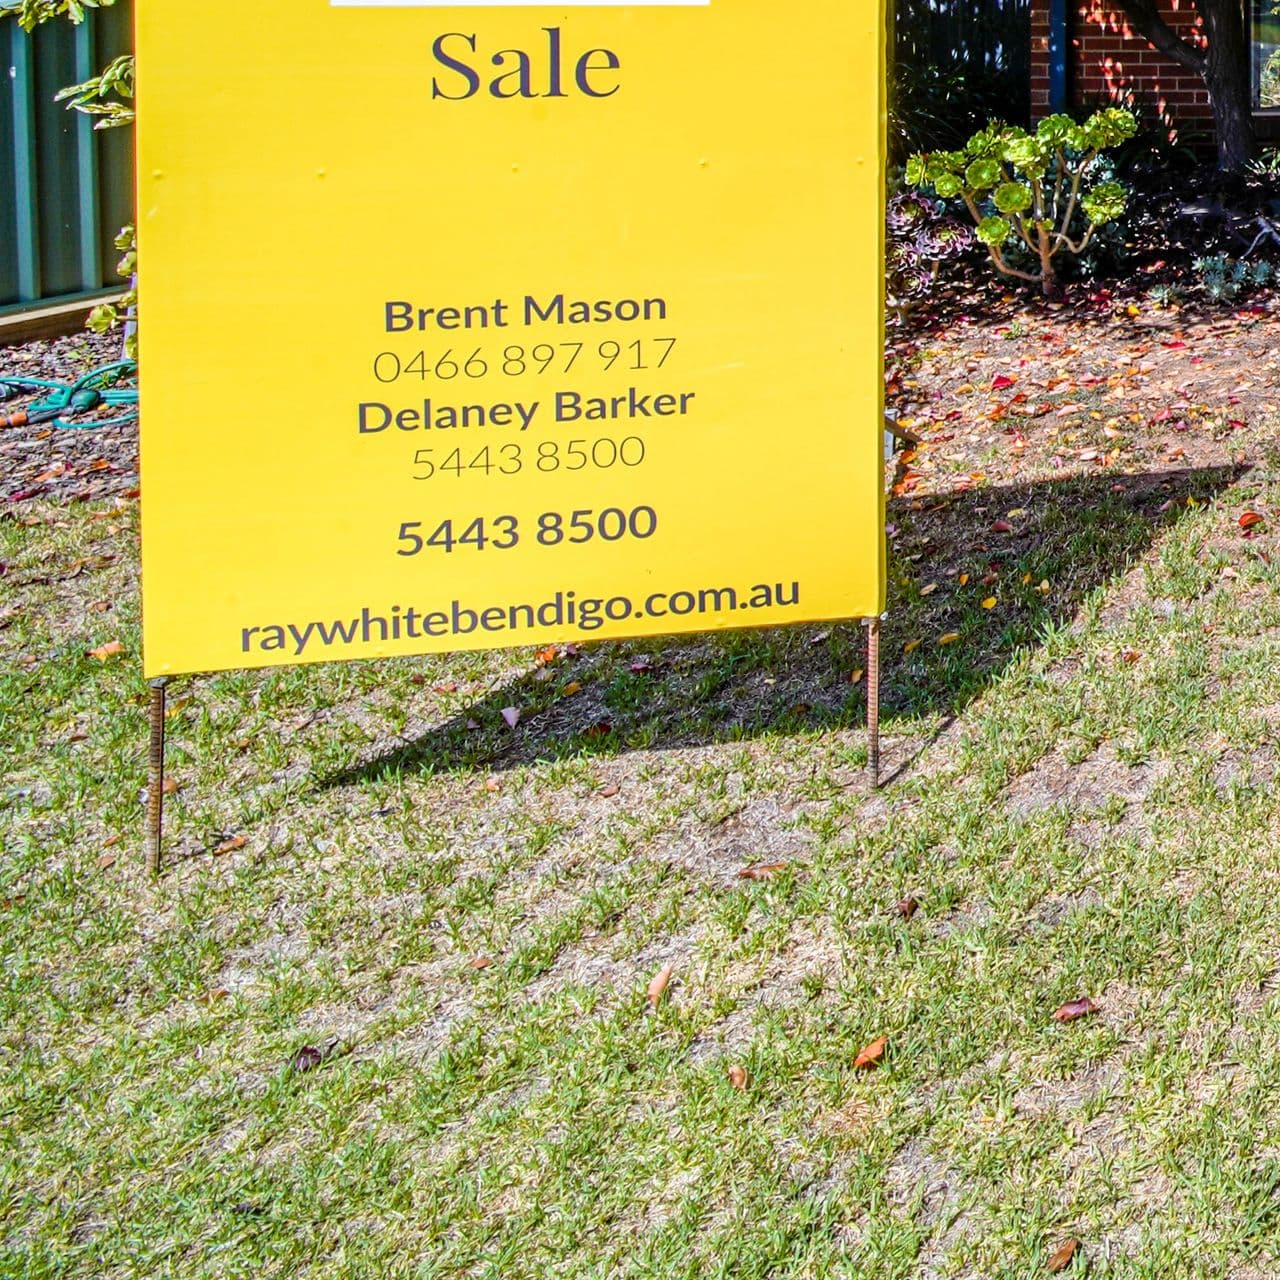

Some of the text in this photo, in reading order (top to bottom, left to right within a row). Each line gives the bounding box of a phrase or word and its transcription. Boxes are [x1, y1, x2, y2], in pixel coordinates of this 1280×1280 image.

[431, 26, 620, 101] Sale
[384, 294, 667, 333] Brent Mason
[373, 337, 677, 383] 0466 897 917
[358, 387, 696, 434] Delaney Barker
[412, 436, 645, 480] 5443 8500
[396, 505, 657, 557] 5443 8500
[241, 580, 800, 655] raywhitebendigo.com.au
